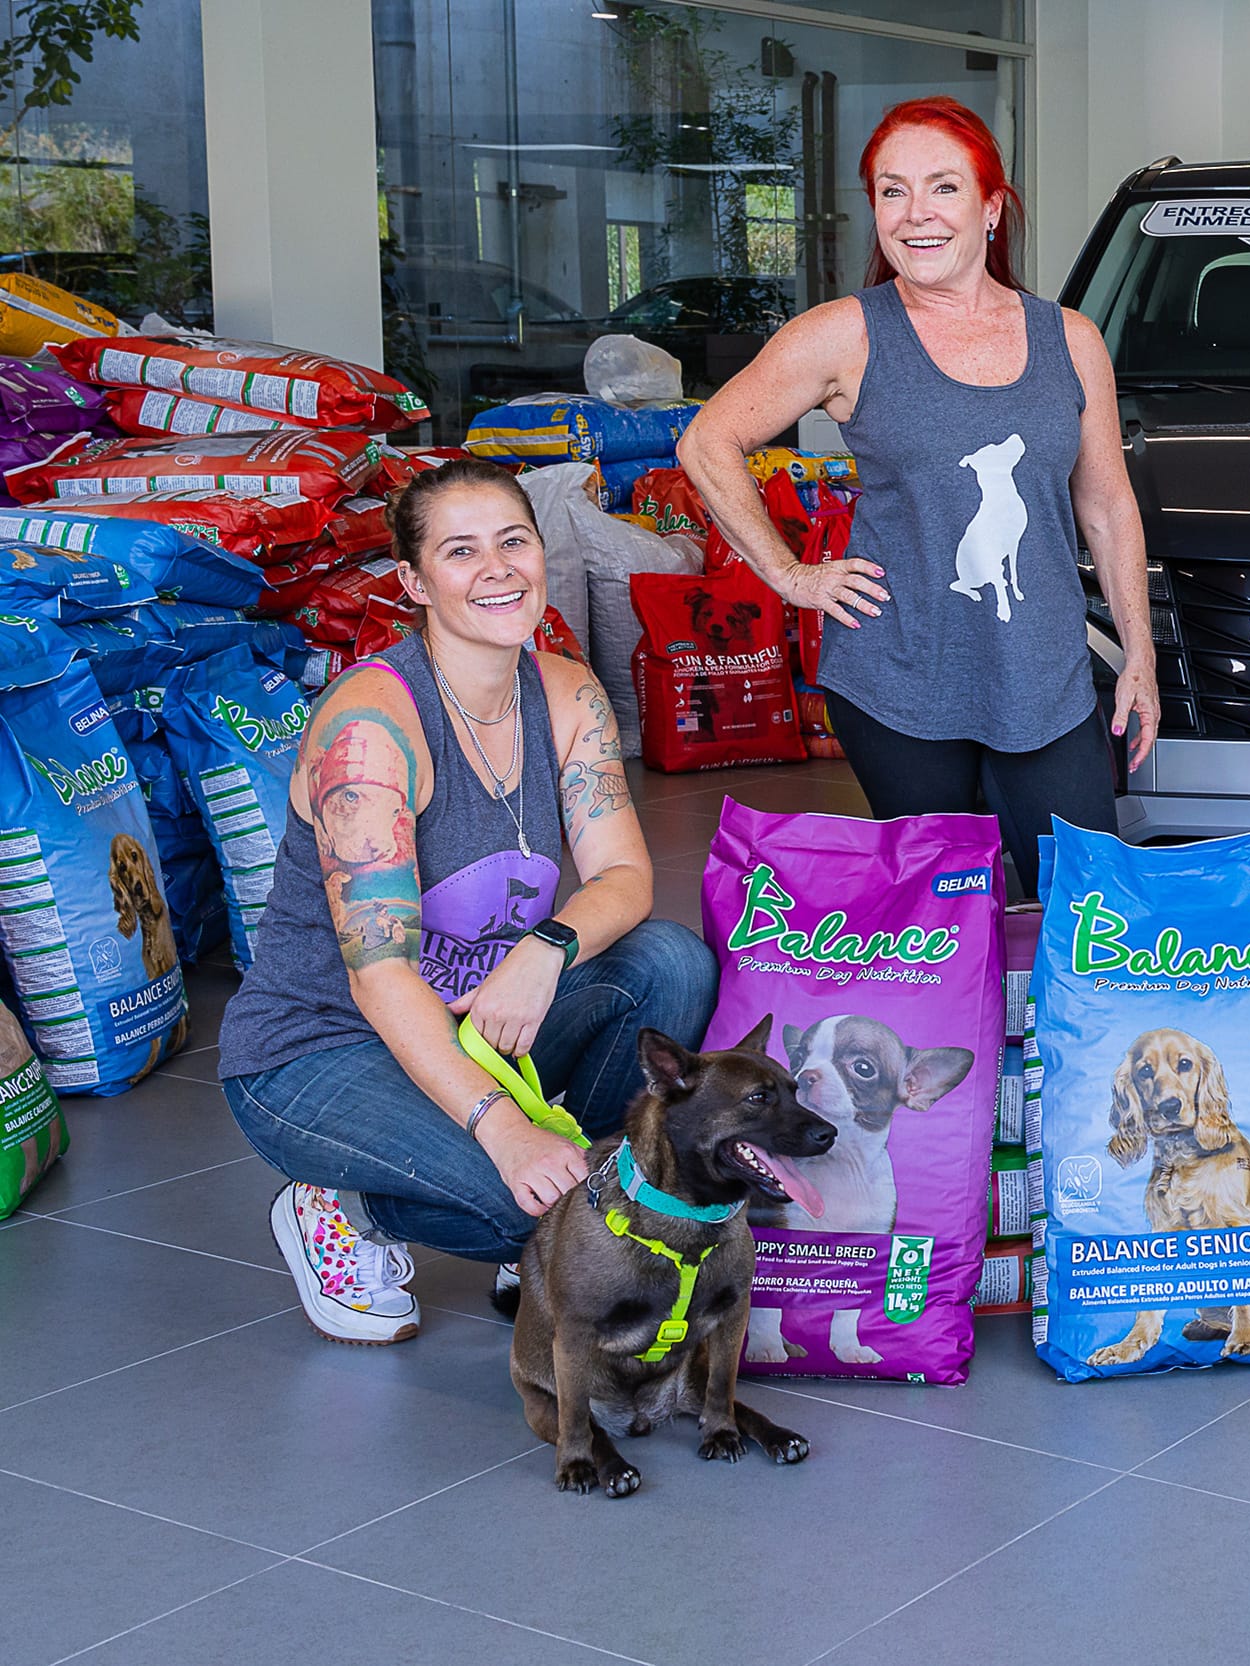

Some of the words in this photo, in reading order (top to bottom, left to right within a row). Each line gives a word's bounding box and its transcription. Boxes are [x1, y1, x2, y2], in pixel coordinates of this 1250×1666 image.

[672, 655, 701, 668] FUN
[705, 655, 716, 665] &
[718, 645, 782, 665] FAITHFUL
[75, 707, 110, 732] BELINA
[936, 874, 987, 893] BELINA
[728, 863, 959, 964] Balance
[737, 956, 811, 976] Premium
[816, 967, 852, 985] Dog
[857, 967, 942, 985] Nutrition
[1094, 978, 1169, 992] Premium
[1175, 980, 1209, 996] Dog
[109, 983, 163, 1018] BALANCE
[788, 1243, 832, 1257] SMALL
[835, 1246, 877, 1259] BREED
[1072, 1238, 1179, 1263] BALANCE
[893, 1267, 922, 1278] NET
[1072, 1268, 1105, 1277] Extruded
[1106, 1265, 1140, 1274] Balanced
[1142, 1264, 1161, 1272] Food
[1163, 1263, 1174, 1271] for
[1175, 1262, 1197, 1270] Adult
[1199, 1261, 1218, 1271] Dogs
[786, 1277, 811, 1287] RAZA
[814, 1278, 858, 1289] PEQUEÑA
[1069, 1285, 1127, 1299] BALANCE
[1130, 1282, 1174, 1296] PERRO
[1177, 1279, 1229, 1294] ADULTO
